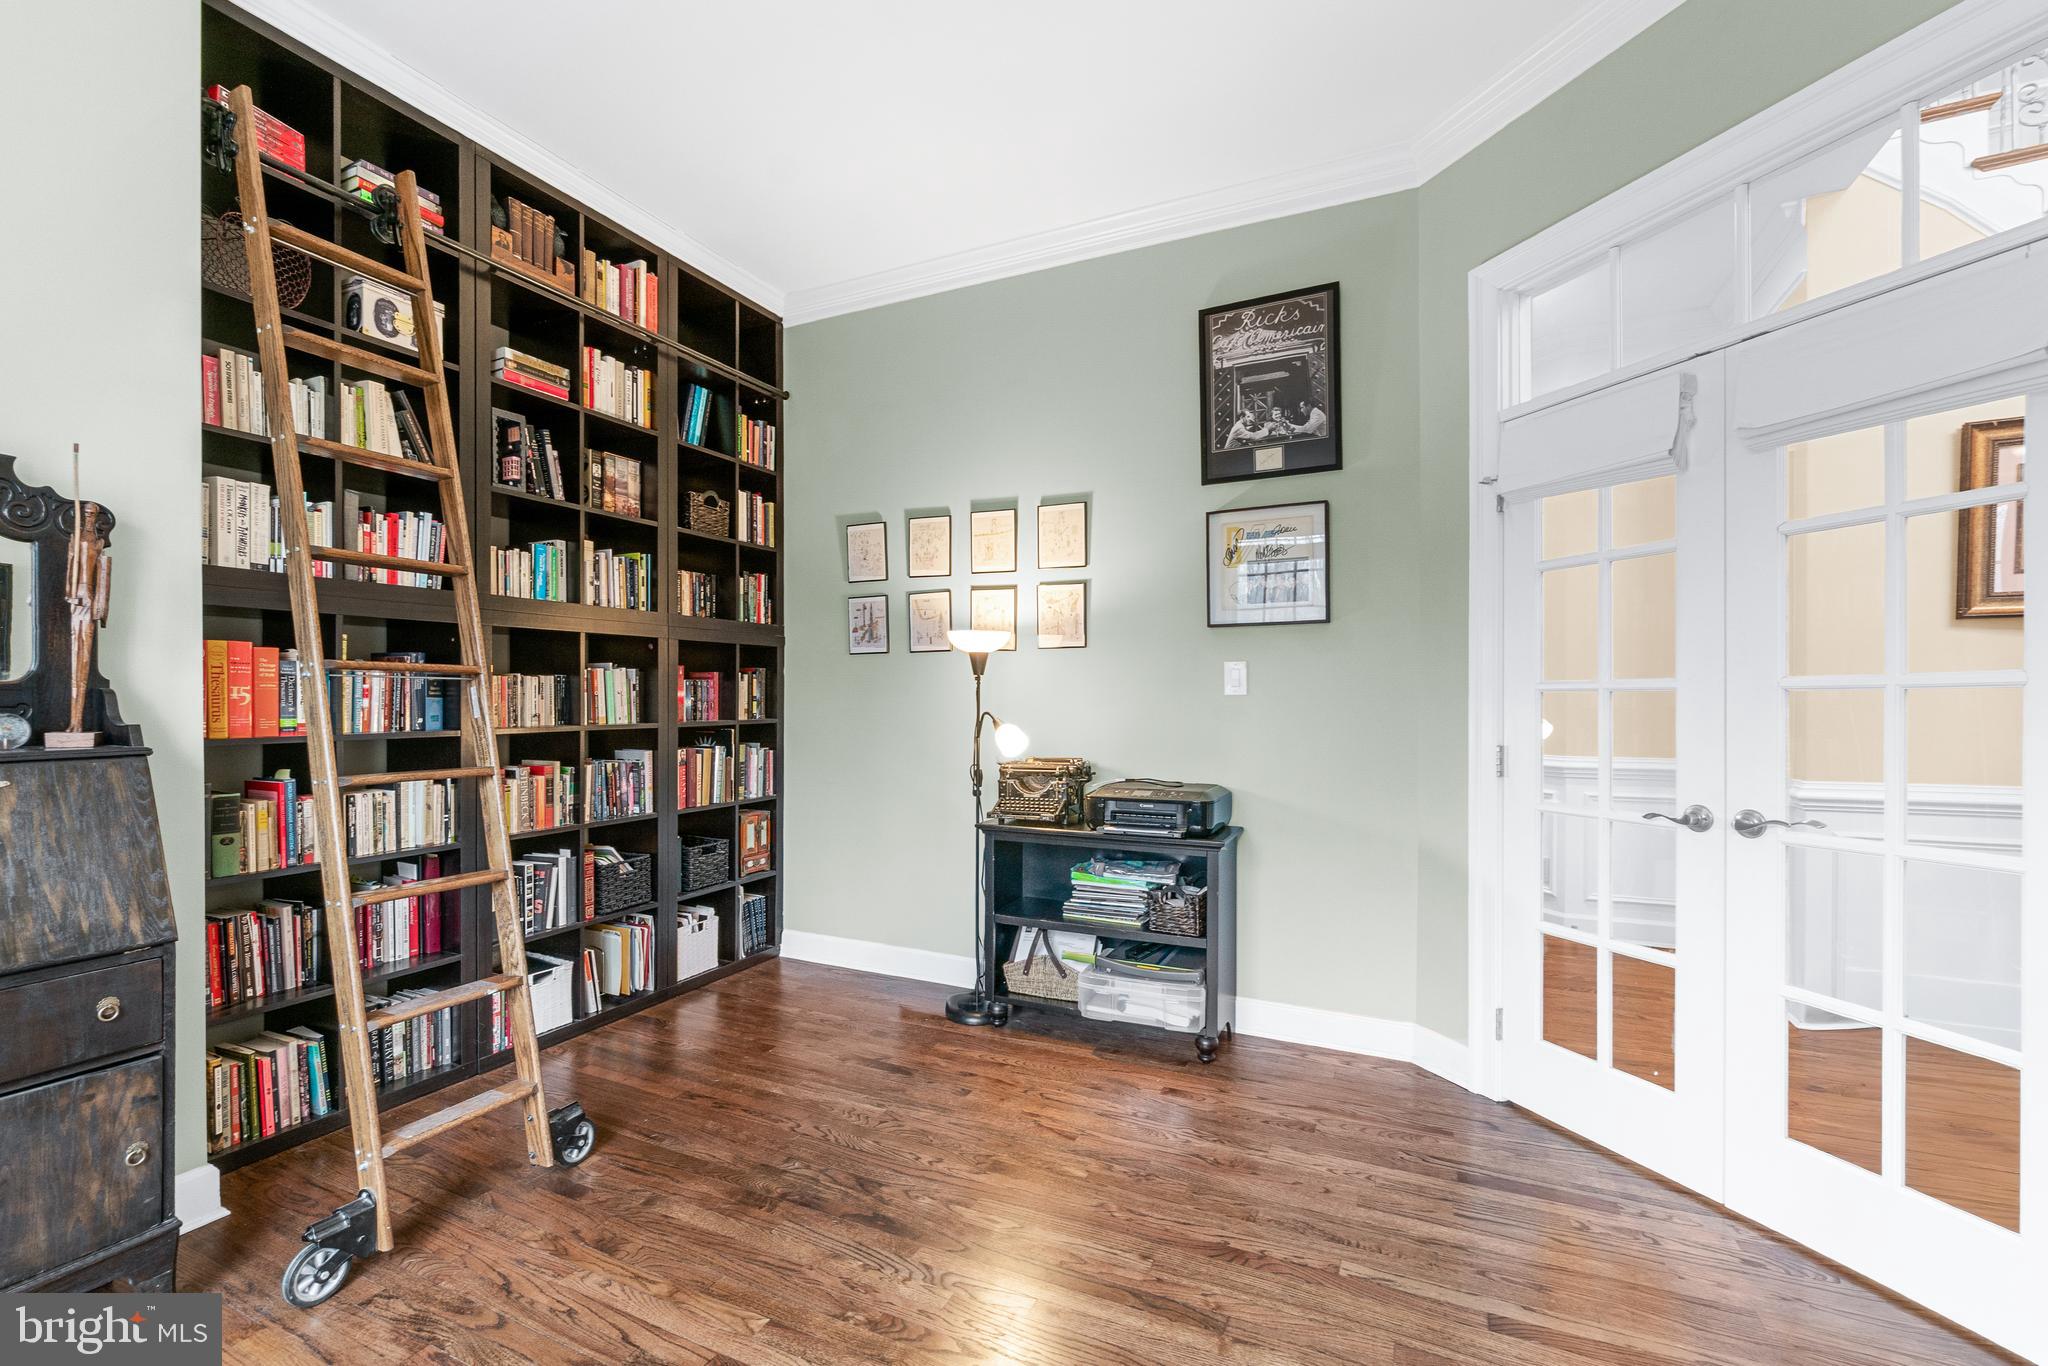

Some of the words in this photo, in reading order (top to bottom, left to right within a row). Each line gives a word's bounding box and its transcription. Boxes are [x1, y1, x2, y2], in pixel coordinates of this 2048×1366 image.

[1235, 306, 1300, 330] Rick's
[211, 662, 224, 724] Thesaurus
[230, 686, 251, 705] 15
[520, 770, 530, 819] STEINBECK
[384, 1028, 393, 1067] SWERVE
